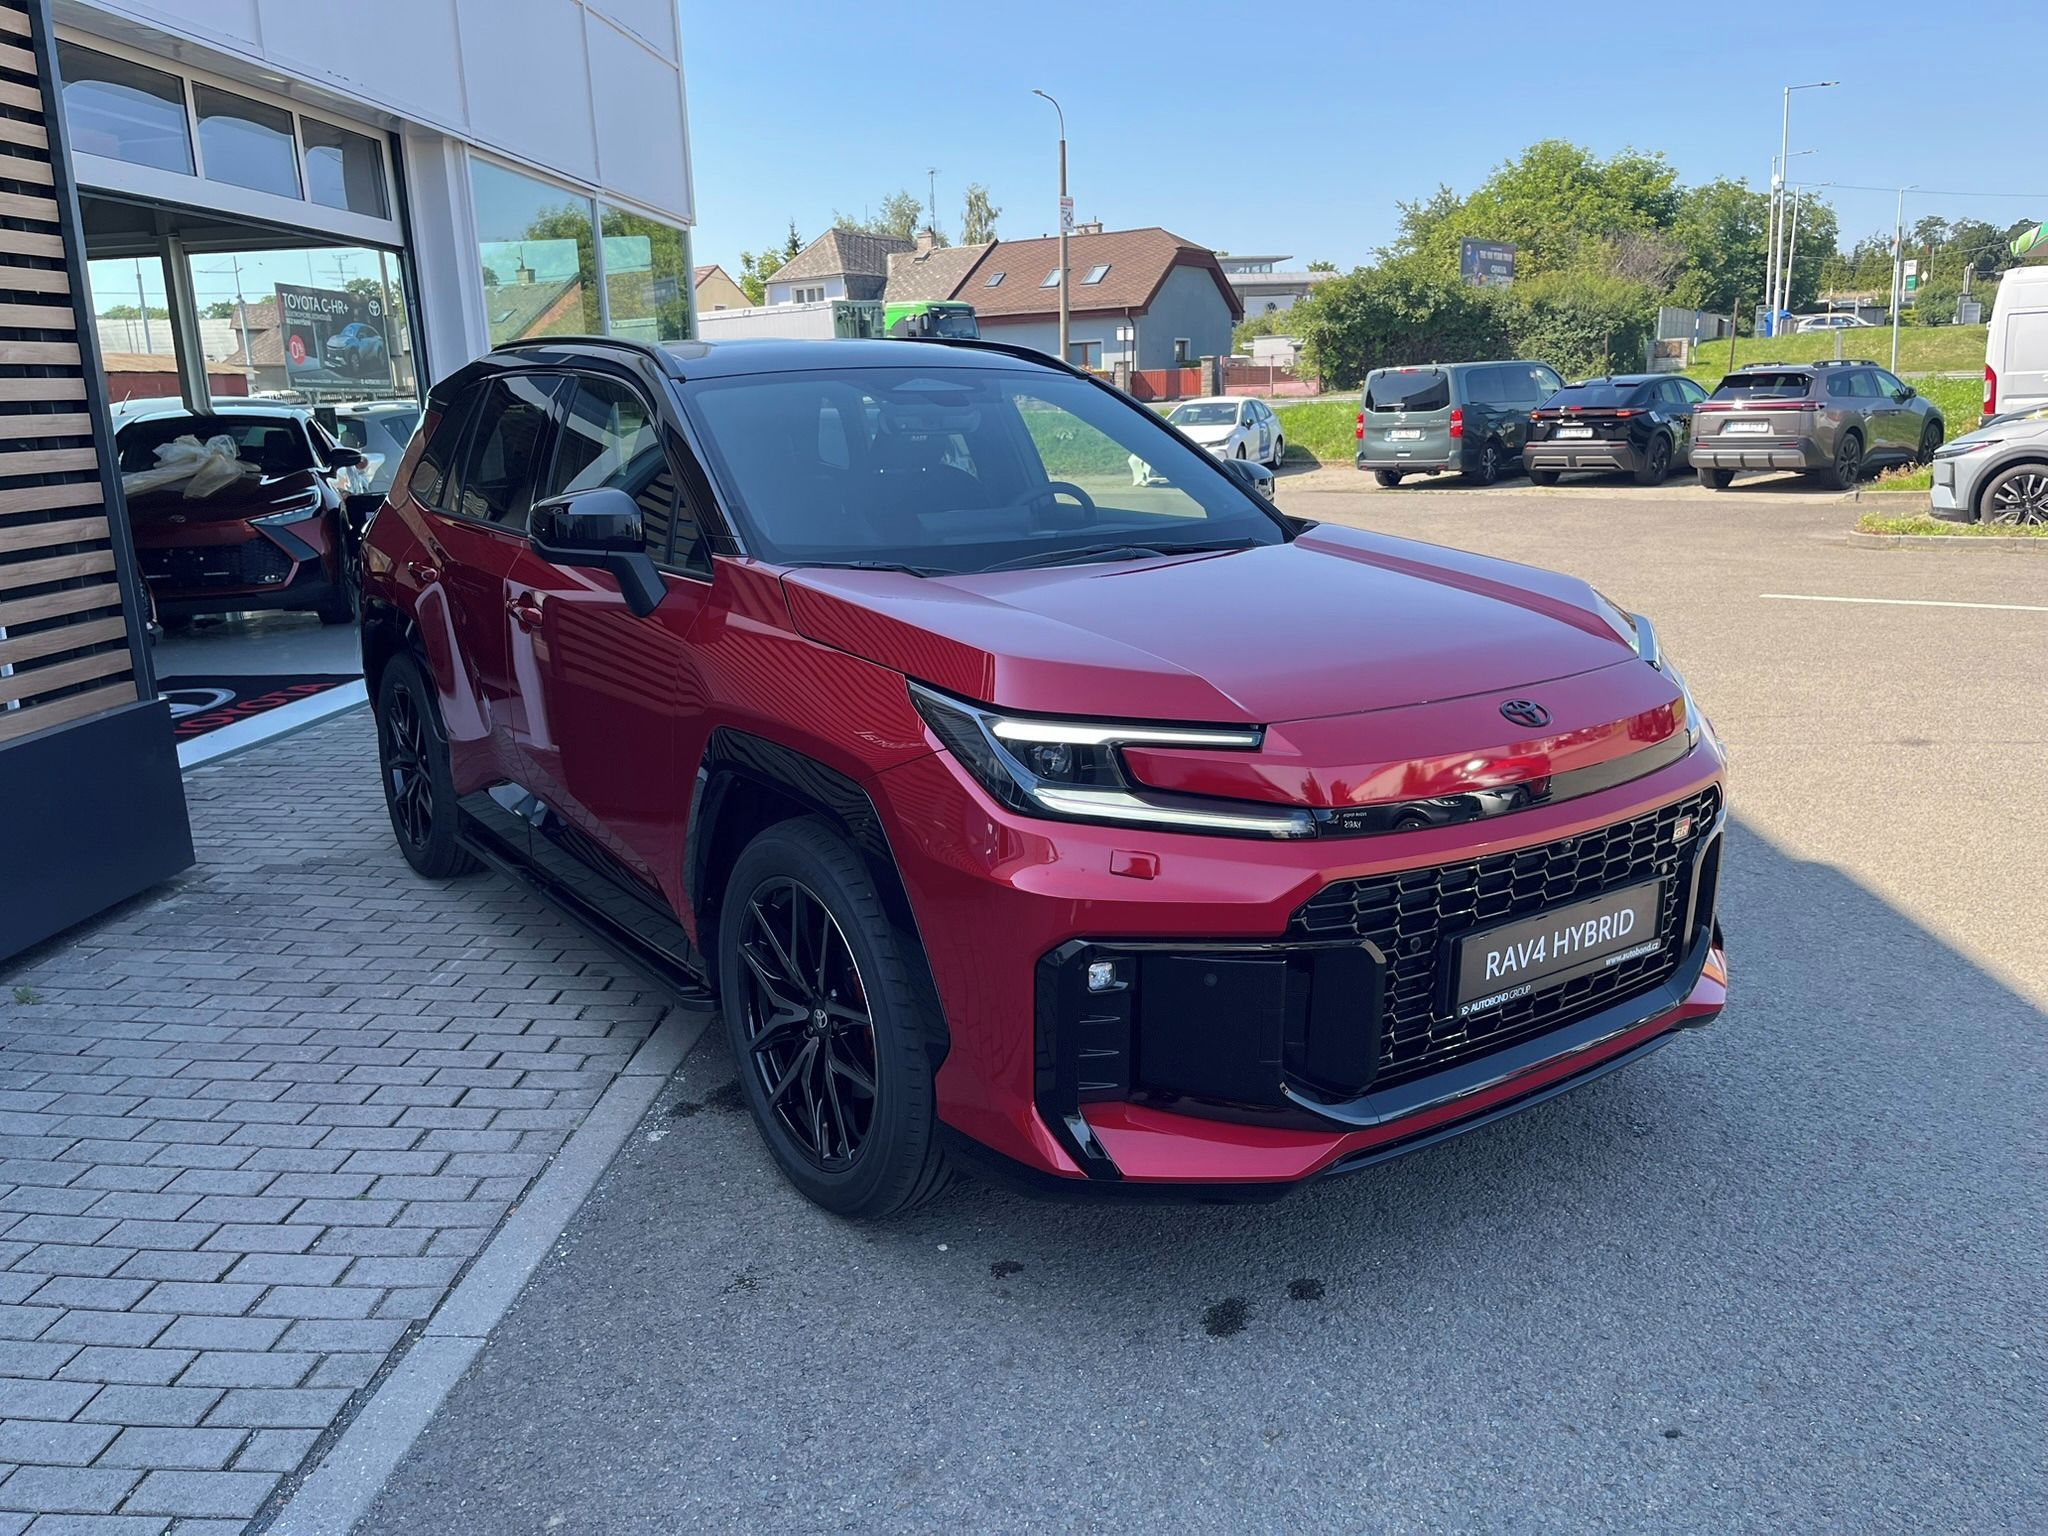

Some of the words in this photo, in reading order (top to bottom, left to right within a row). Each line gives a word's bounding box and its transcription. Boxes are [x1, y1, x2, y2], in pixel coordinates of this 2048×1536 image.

[282, 293, 321, 312] TOYOTA
[321, 299, 350, 315] C-HR+
[1485, 935, 1546, 980] RAV4
[1552, 908, 1635, 958] HYBRID
[1605, 941, 1660, 966] www.autobond.cz
[1470, 991, 1509, 1012] AUTOBOND
[1508, 984, 1532, 1002] GROUP
